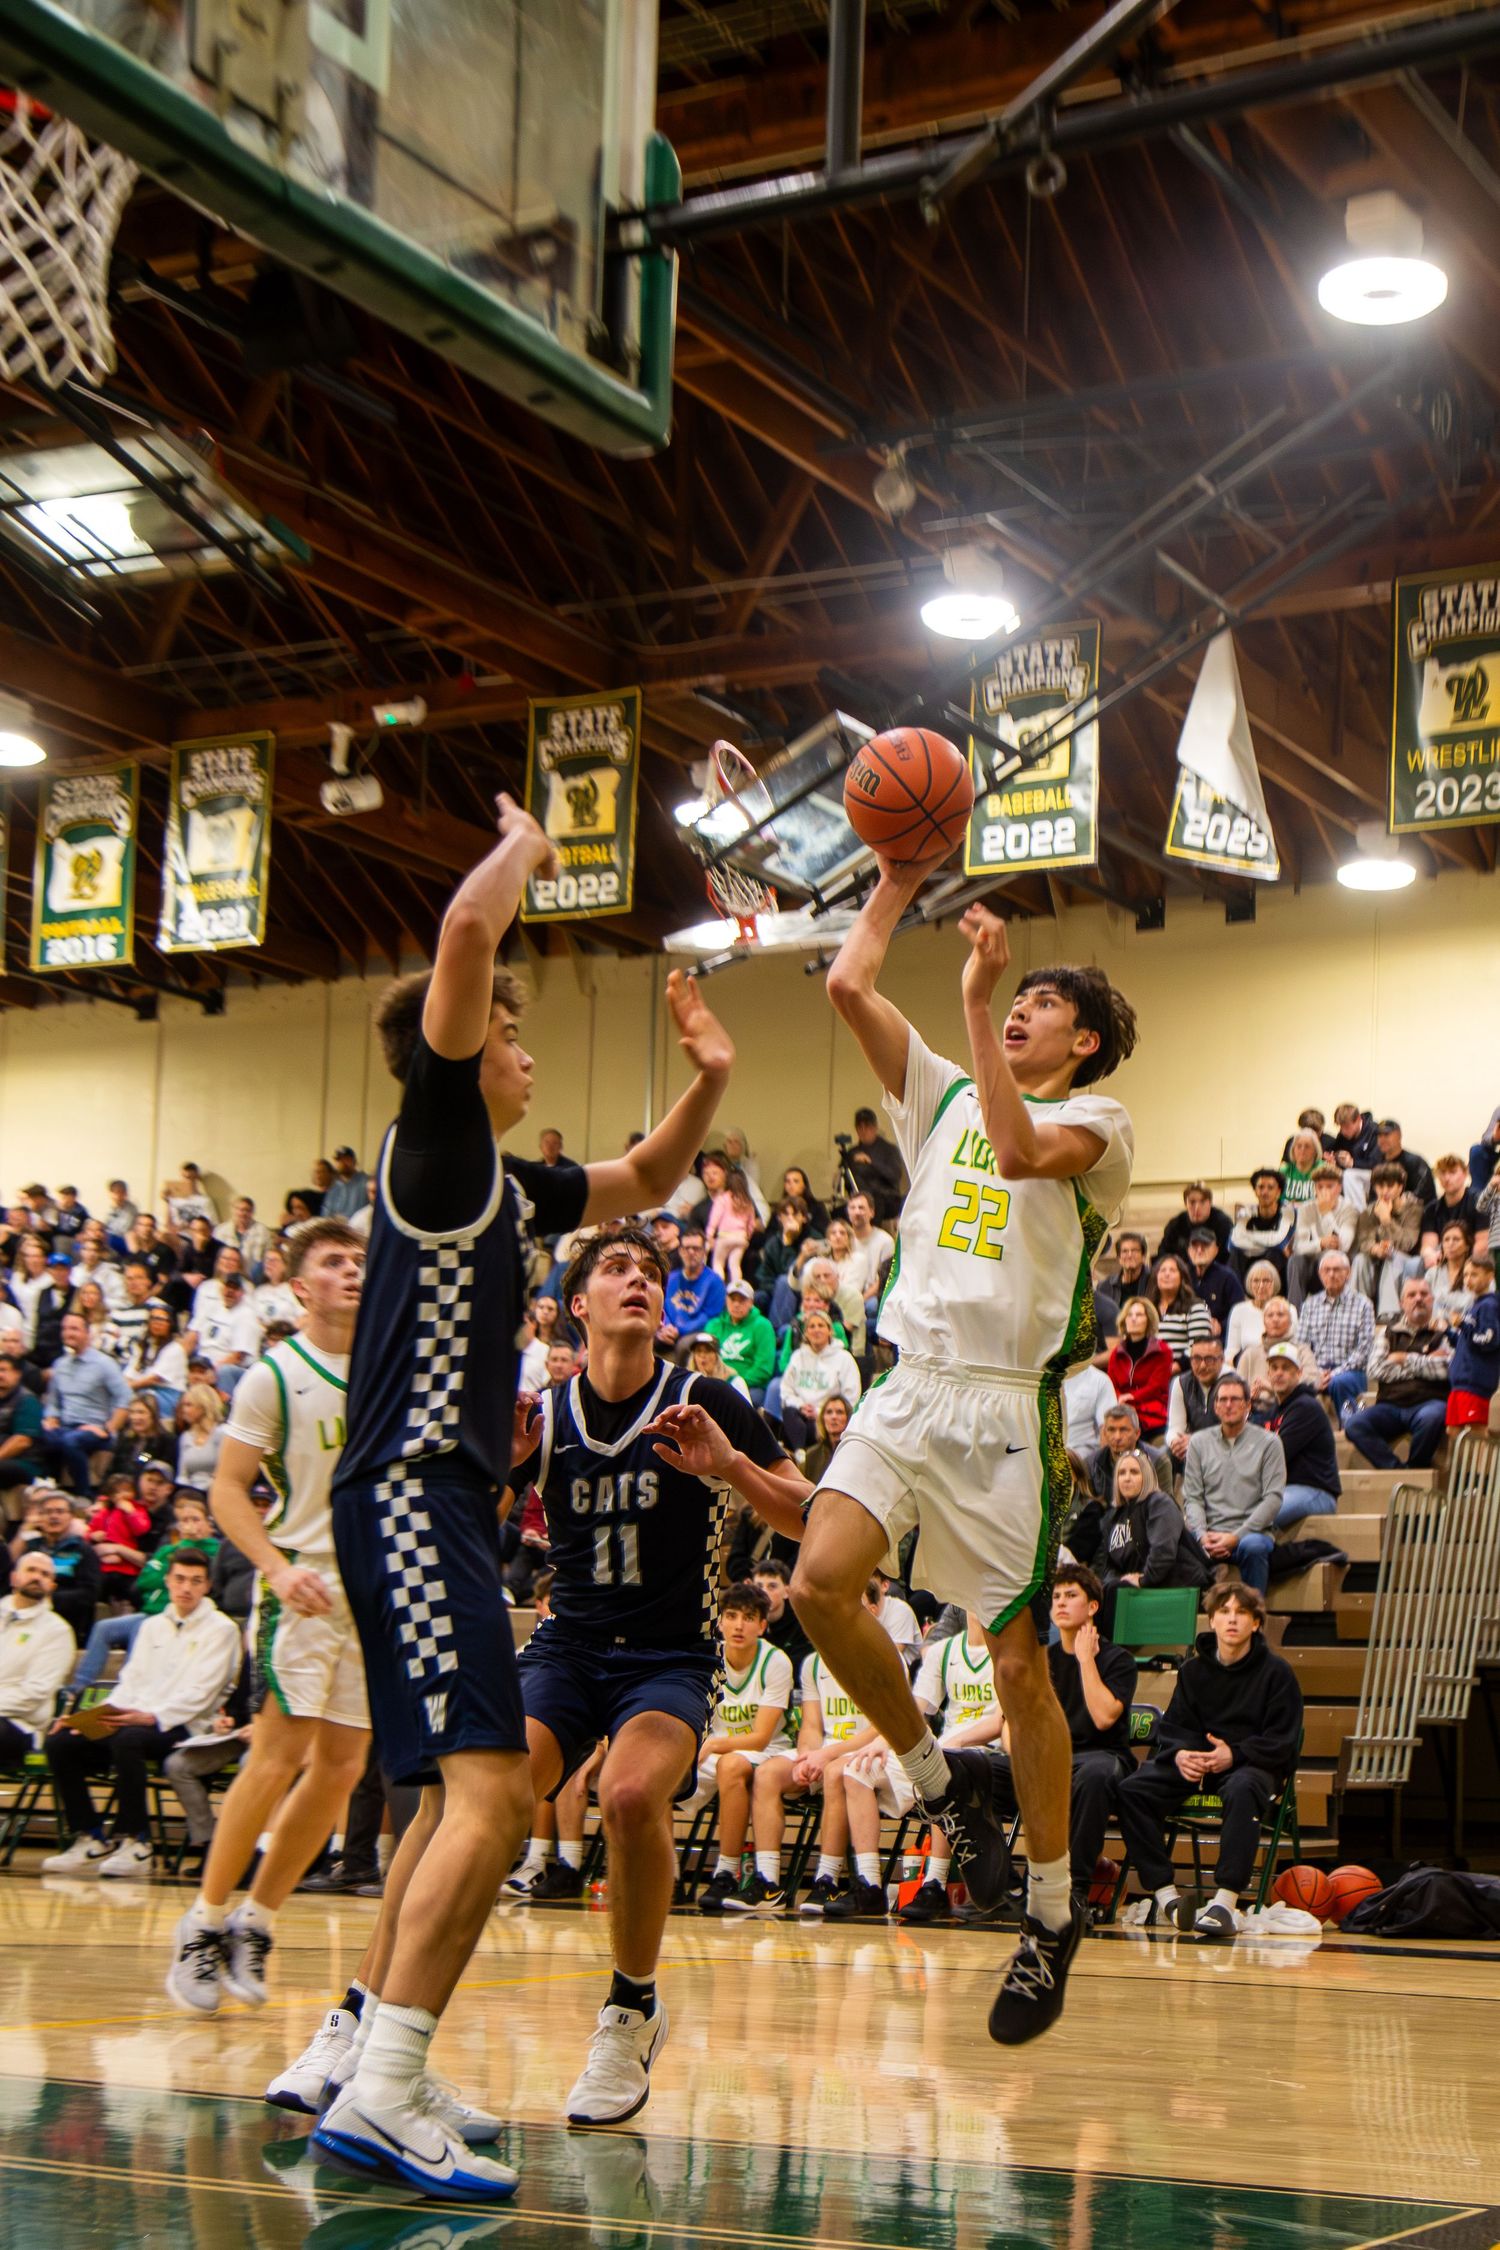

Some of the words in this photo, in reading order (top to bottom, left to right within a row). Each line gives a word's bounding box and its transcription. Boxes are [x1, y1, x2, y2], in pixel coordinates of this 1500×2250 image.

[1423, 579, 1500, 624] STAT
[1407, 736, 1500, 774] WRESTLI
[987, 784, 1074, 818] BASEBALL
[1414, 770, 1500, 820] 2023
[552, 842, 619, 867] OTBALL
[981, 816, 1078, 862] 2022
[1182, 807, 1269, 859] 2025
[535, 871, 620, 911] 2022
[938, 1179, 1011, 1261] 22
[570, 1469, 660, 1514] CATS
[591, 1523, 643, 1587] 11
[953, 1682, 993, 1702] LIONS
